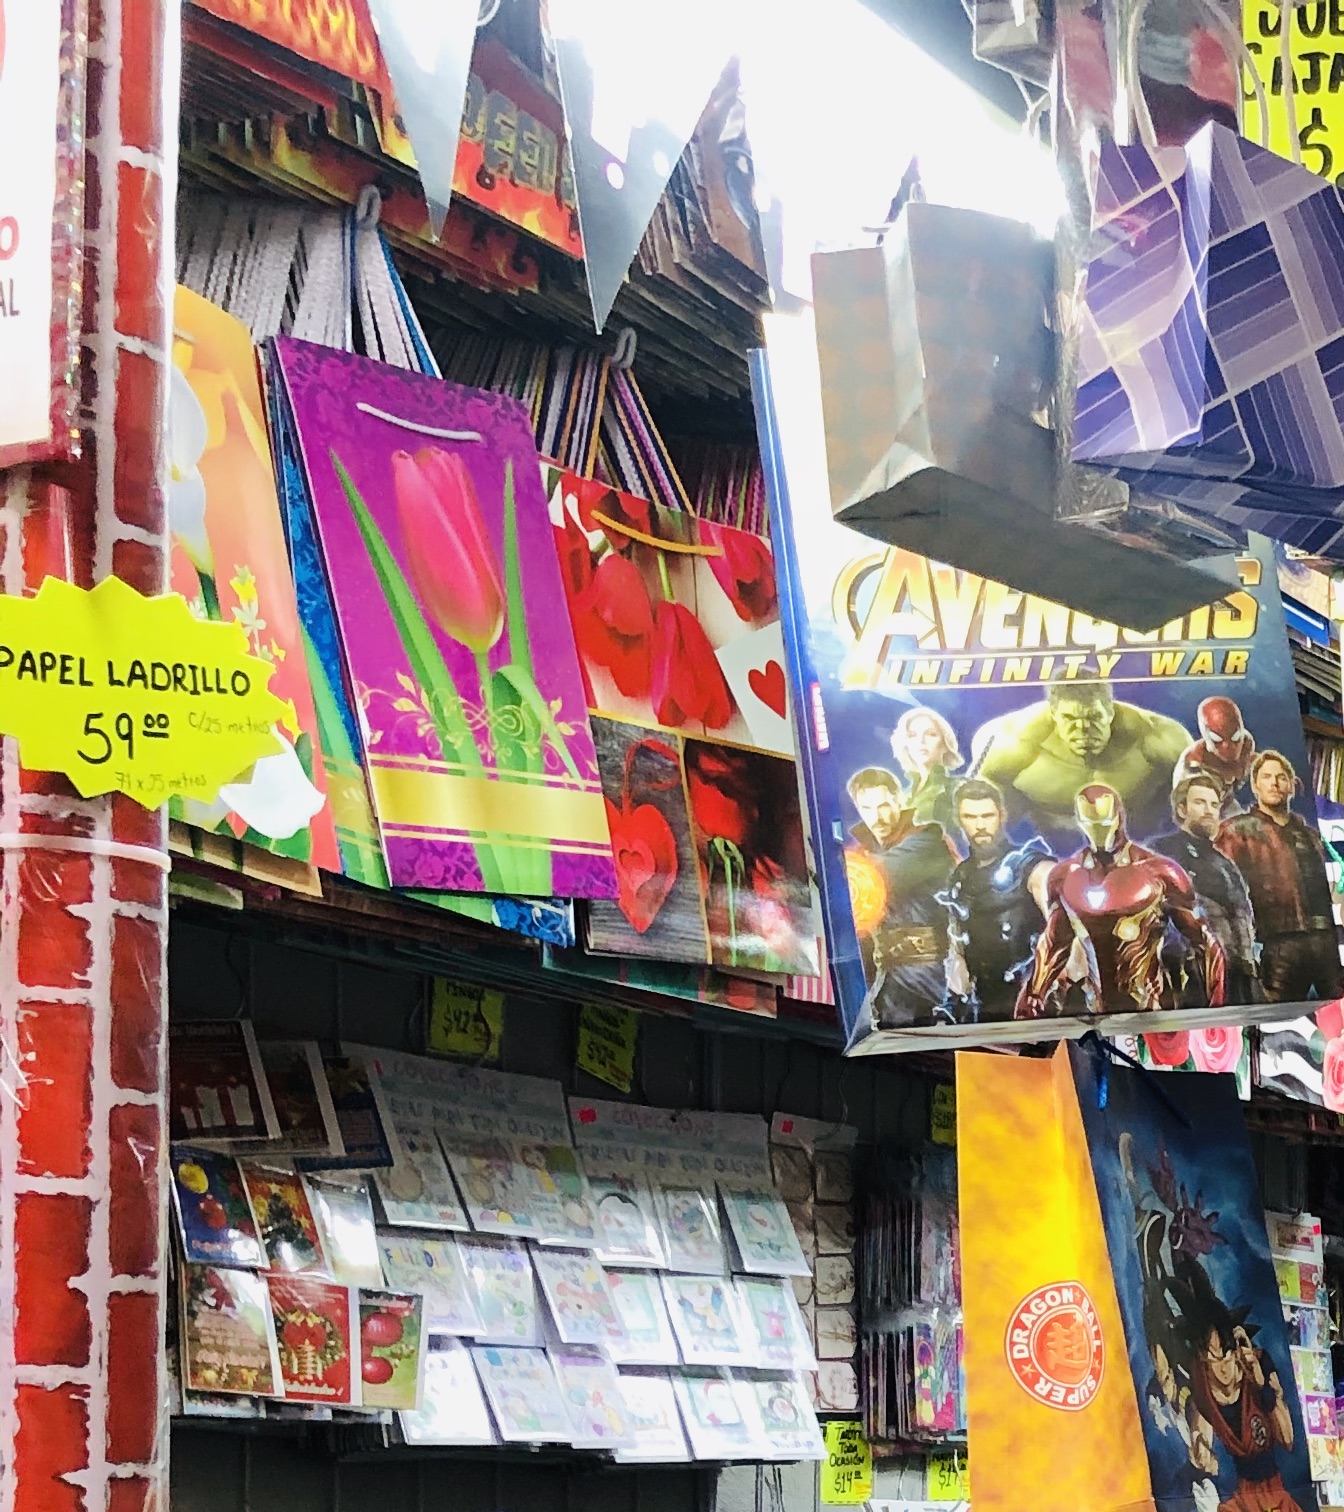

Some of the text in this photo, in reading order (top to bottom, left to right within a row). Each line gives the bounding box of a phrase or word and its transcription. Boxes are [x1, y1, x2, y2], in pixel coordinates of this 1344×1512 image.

[107, 659, 251, 697] LADRILLO
[885, 650, 1251, 685] INFINITY WAR
[1012, 1286, 1102, 1361] DRAGON BALL
[1033, 1372, 1098, 1407] SUPER
